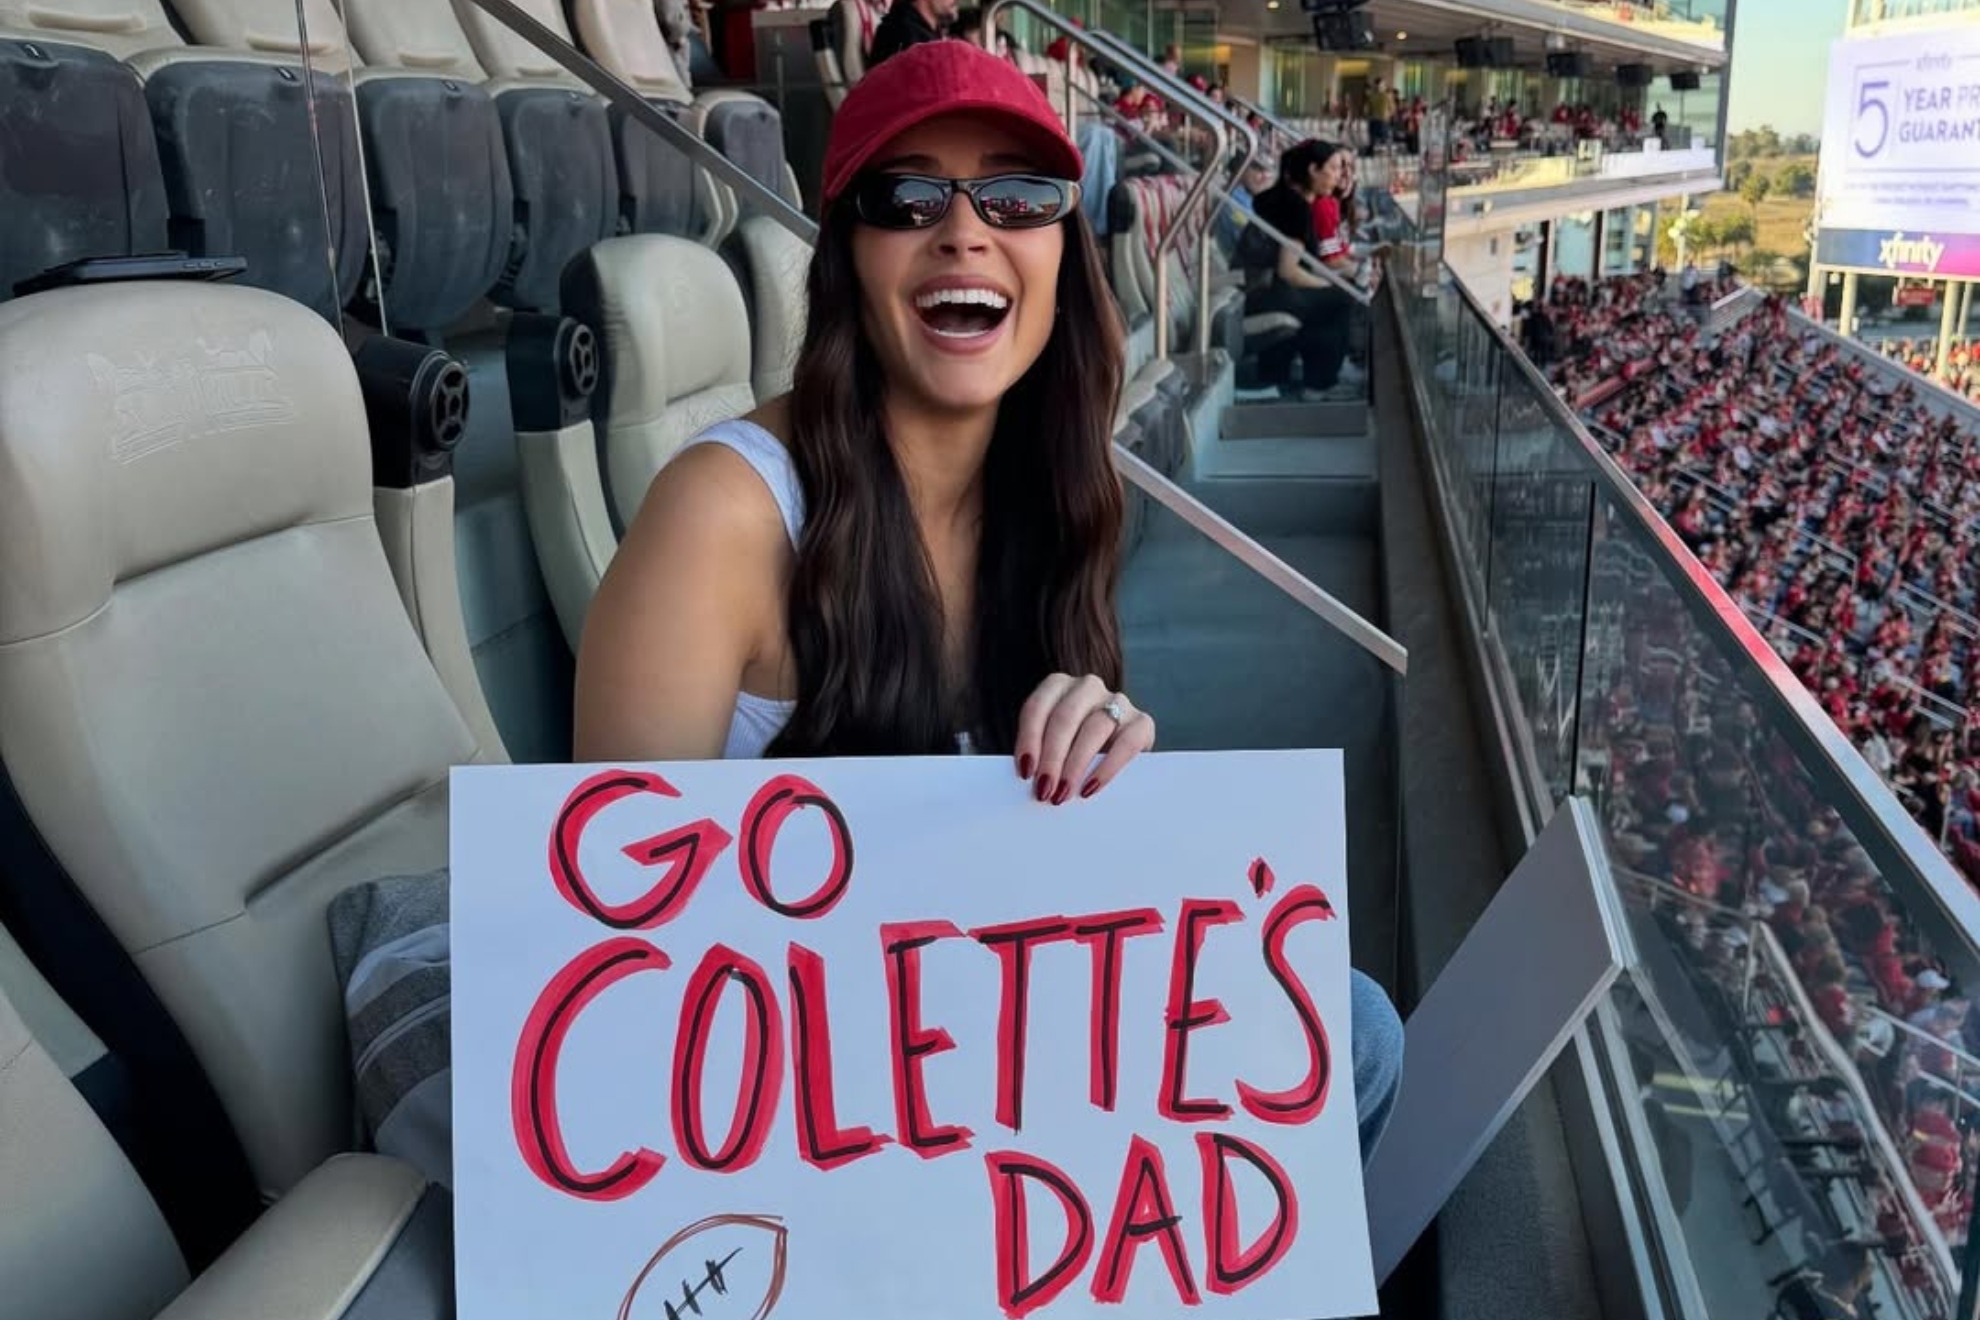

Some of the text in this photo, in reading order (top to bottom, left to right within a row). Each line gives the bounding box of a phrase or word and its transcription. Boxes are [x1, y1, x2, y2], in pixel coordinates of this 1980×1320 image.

[1854, 79, 1890, 159] 5
[1904, 85, 1952, 113] YEAR
[1878, 230, 1945, 272] xfinity
[548, 769, 855, 931] GO
[510, 856, 1337, 1202] COLETTE'S
[983, 1132, 1300, 1319] DAD
